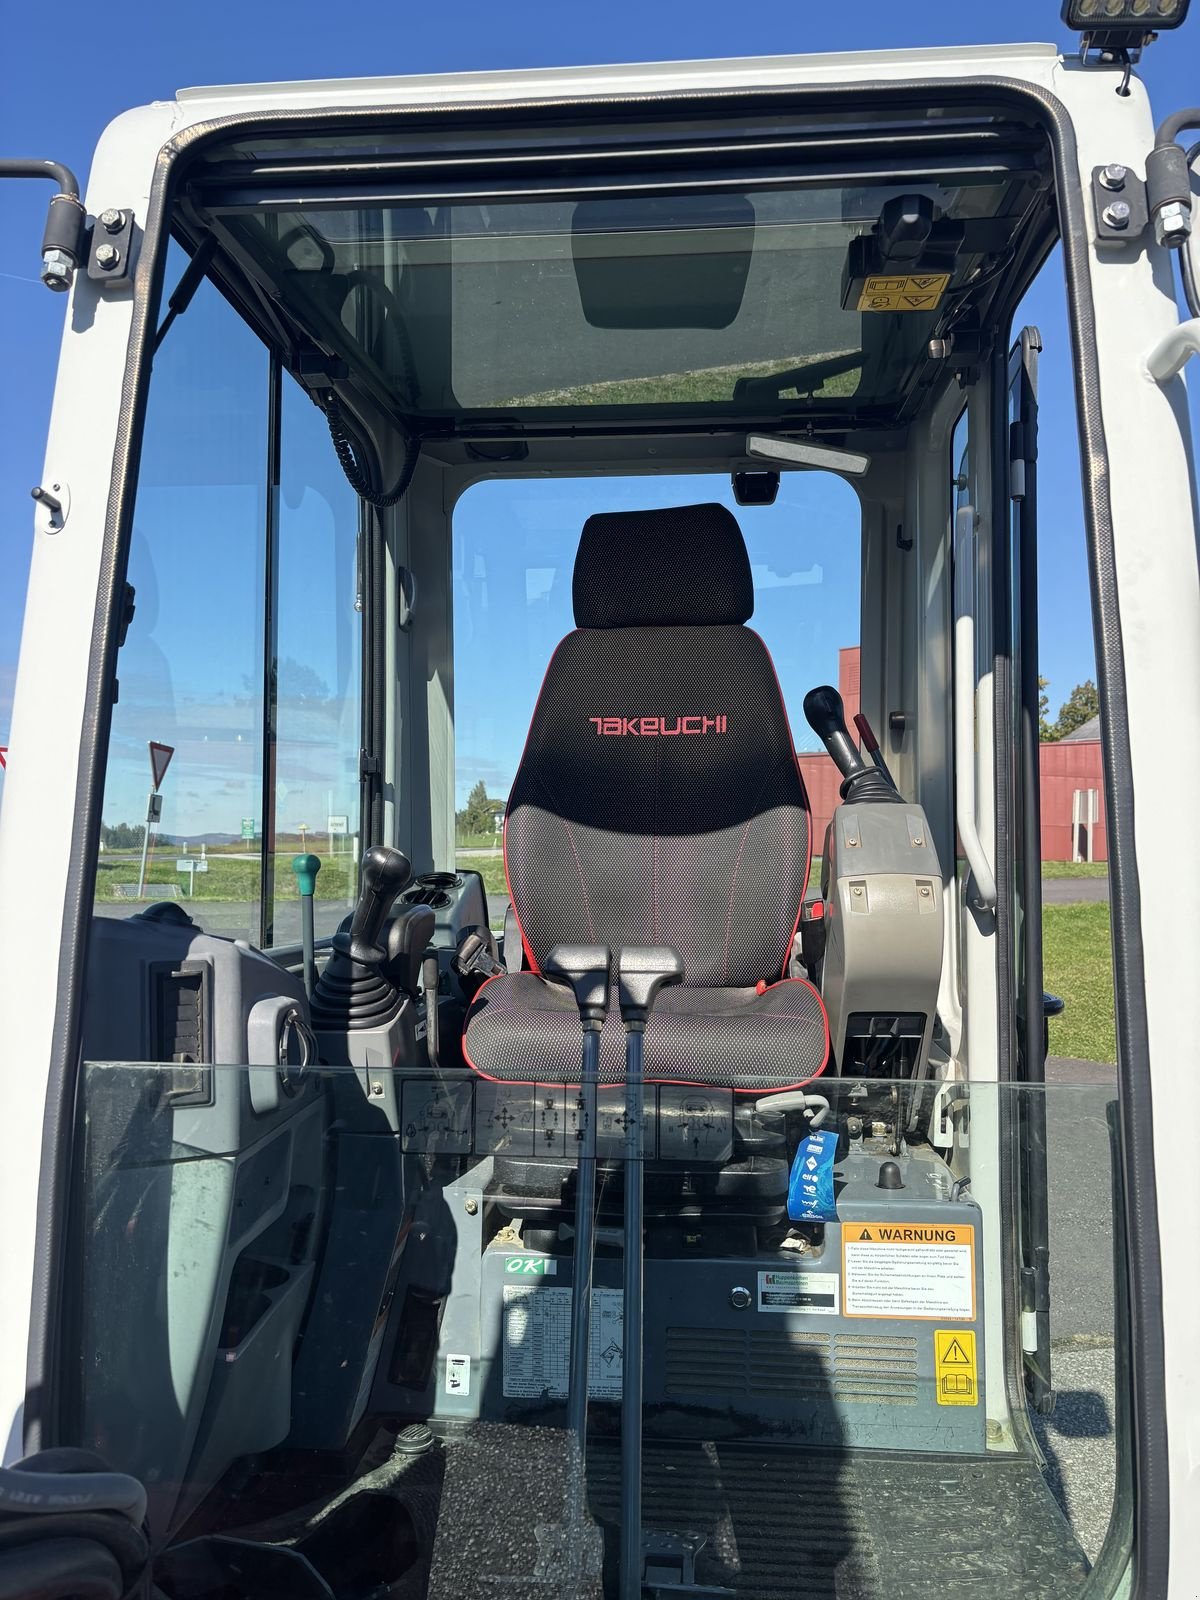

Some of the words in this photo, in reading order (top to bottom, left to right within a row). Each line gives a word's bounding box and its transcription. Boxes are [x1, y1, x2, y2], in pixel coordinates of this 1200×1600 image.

[589, 715, 727, 736] TAKEUCHI
[879, 1229, 956, 1242] WARNUNG
[507, 1258, 543, 1273] OK
